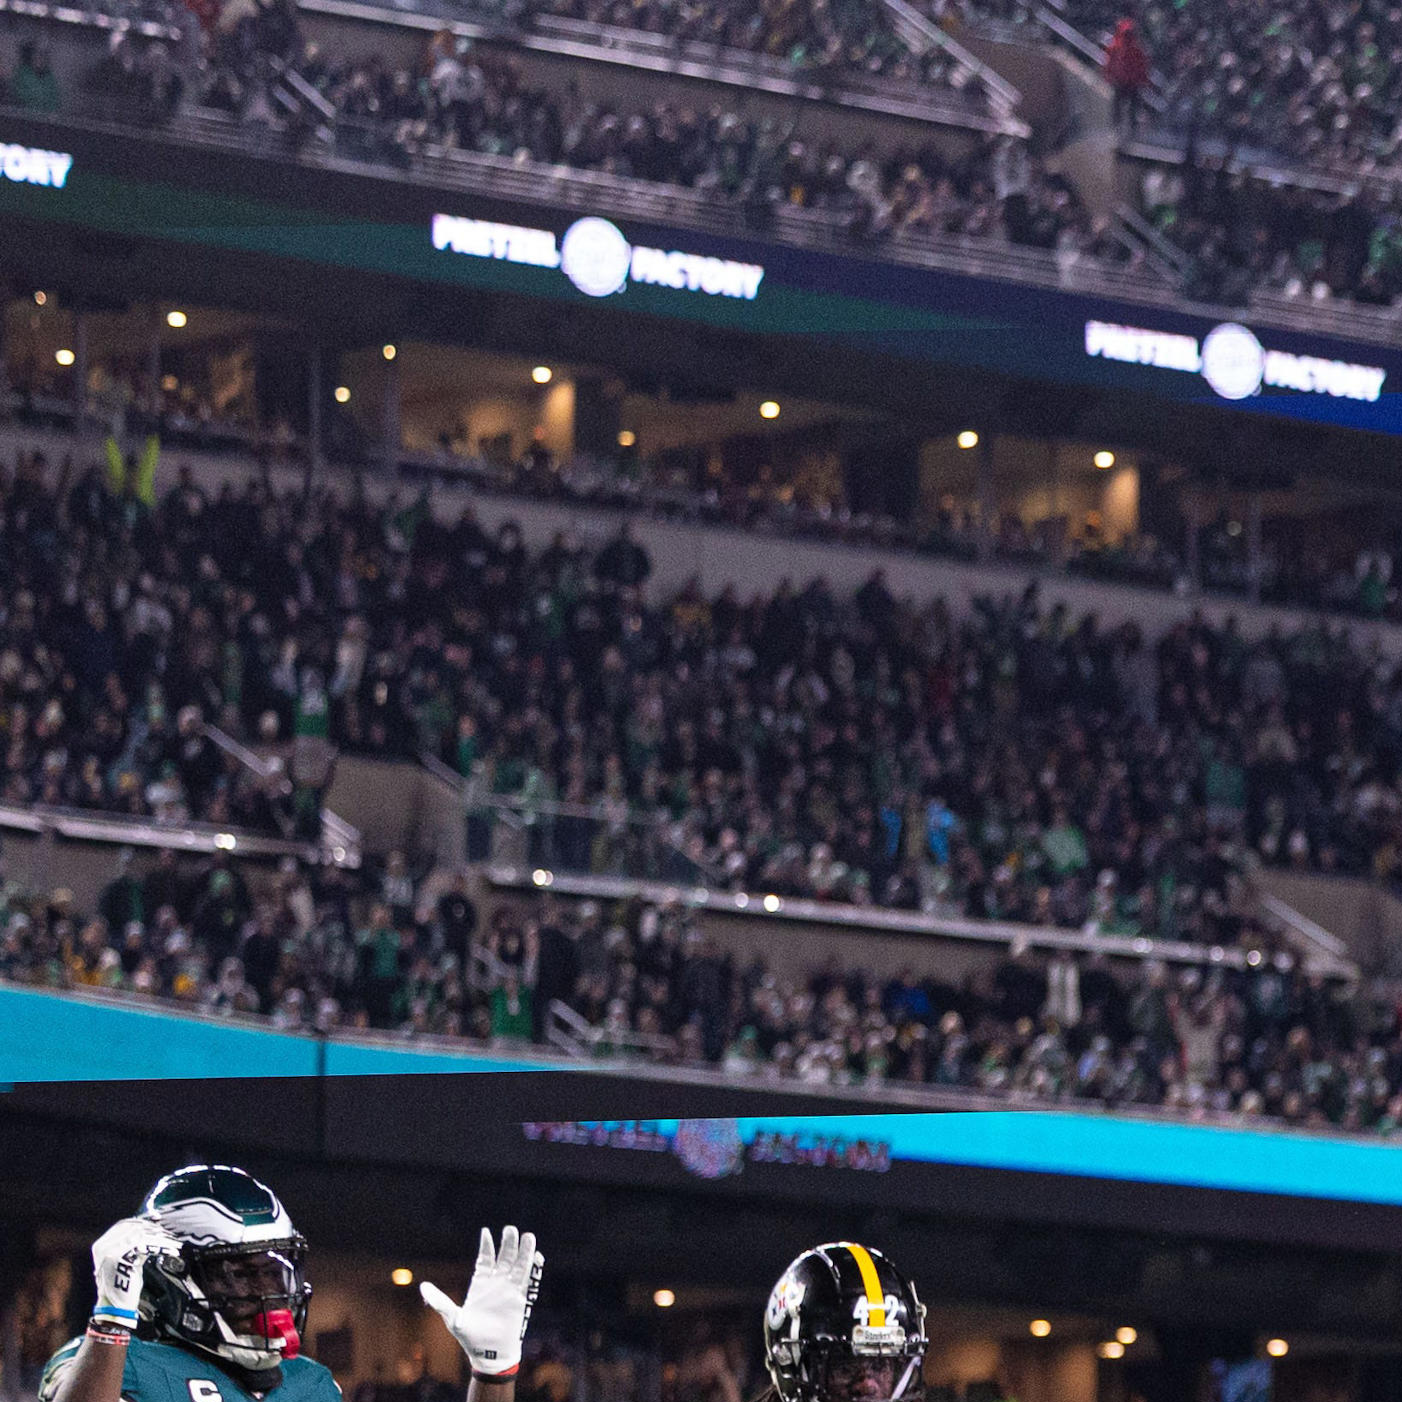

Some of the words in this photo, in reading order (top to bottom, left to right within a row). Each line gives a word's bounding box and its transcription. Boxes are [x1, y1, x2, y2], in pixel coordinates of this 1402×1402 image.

[0, 142, 73, 189] ORY
[432, 213, 560, 269] PRETZEL
[631, 245, 764, 300] FACTORY
[1264, 350, 1386, 402] FACTORY
[852, 1294, 900, 1327] 42
